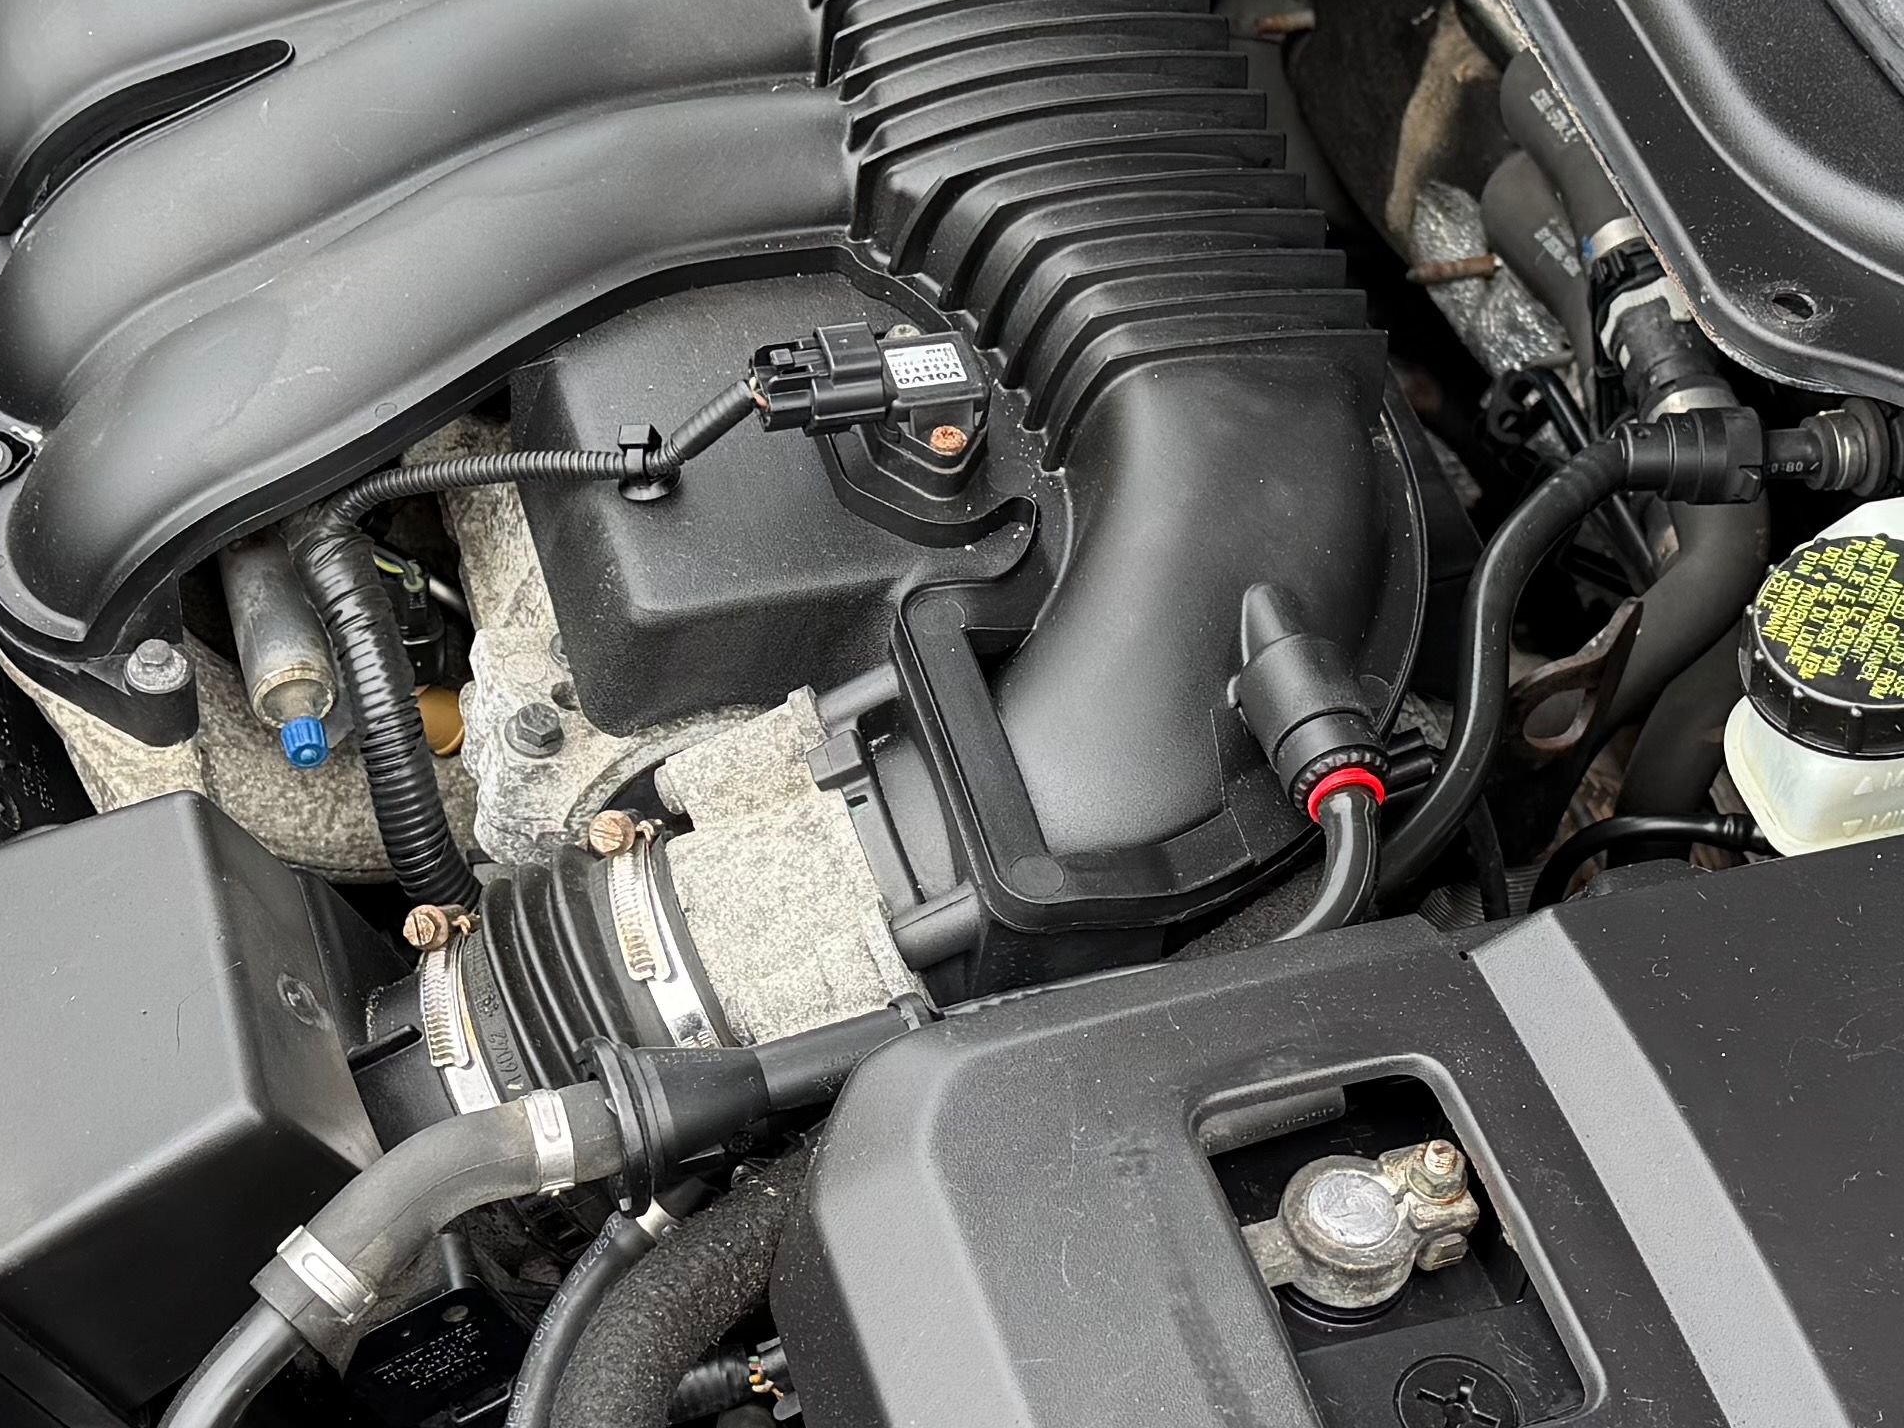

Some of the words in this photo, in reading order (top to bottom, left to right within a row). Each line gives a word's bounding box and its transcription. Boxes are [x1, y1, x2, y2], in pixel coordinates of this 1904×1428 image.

[897, 371, 961, 384] VOLVO
[1817, 544, 1842, 569] DOT
[1831, 537, 1866, 580] PLOYER
[1858, 537, 1886, 569] AVANT
[1812, 571, 1825, 581] 4
[1847, 570, 1868, 586] DE
[1857, 549, 1898, 605] NETTOYER
[1818, 580, 1842, 604] QUE
[1838, 587, 1858, 604] LE
[1758, 576, 1803, 640] CONTENANT
[1775, 582, 1820, 646] PROVENANT
[1808, 606, 1829, 624] DU
[1847, 605, 1868, 623] LE
[1784, 625, 1819, 667] LIQUIDE
[1819, 624, 1858, 676] BOUCHON
[1867, 666, 1897, 700] FROM
